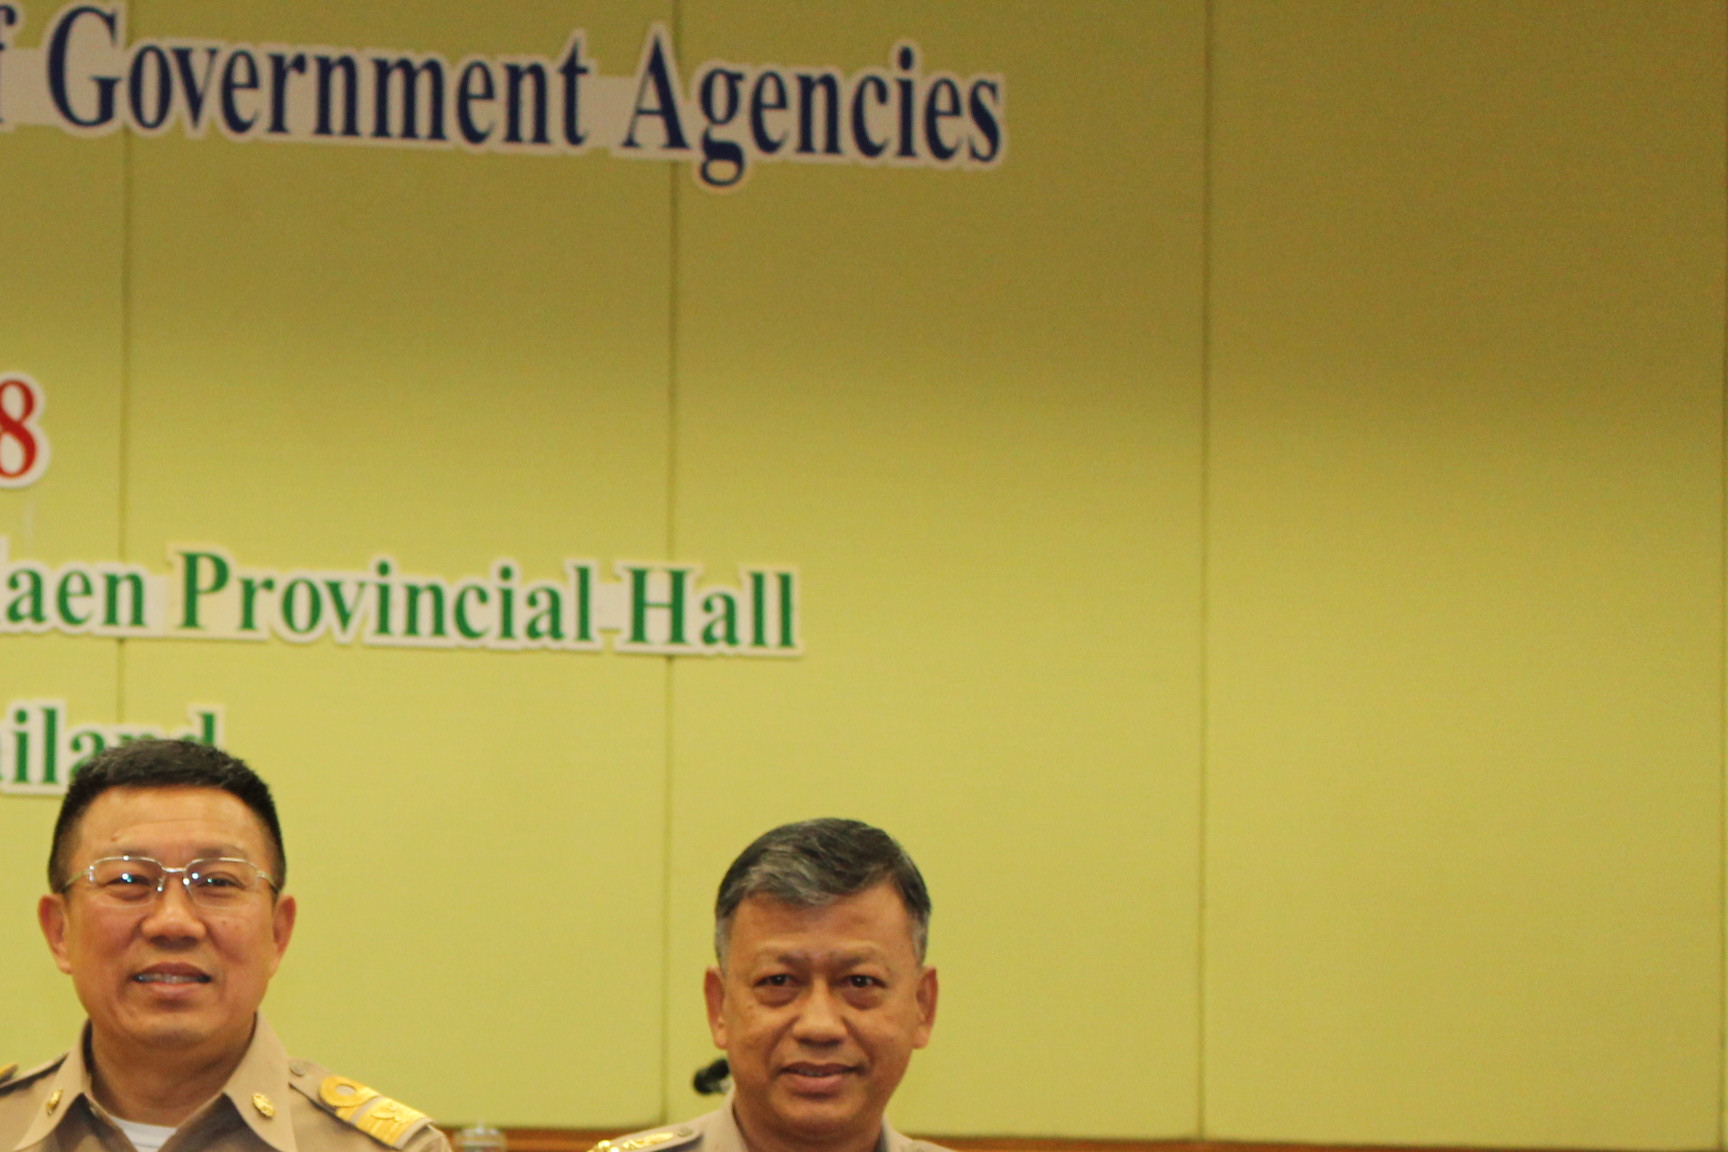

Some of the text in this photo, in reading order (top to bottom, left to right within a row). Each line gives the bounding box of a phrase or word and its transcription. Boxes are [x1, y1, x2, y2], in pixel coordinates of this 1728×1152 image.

[46, 5, 589, 147] Government
[621, 36, 1001, 188] Agencies
[182, 552, 591, 641] Provincial
[630, 567, 794, 648] Hall
